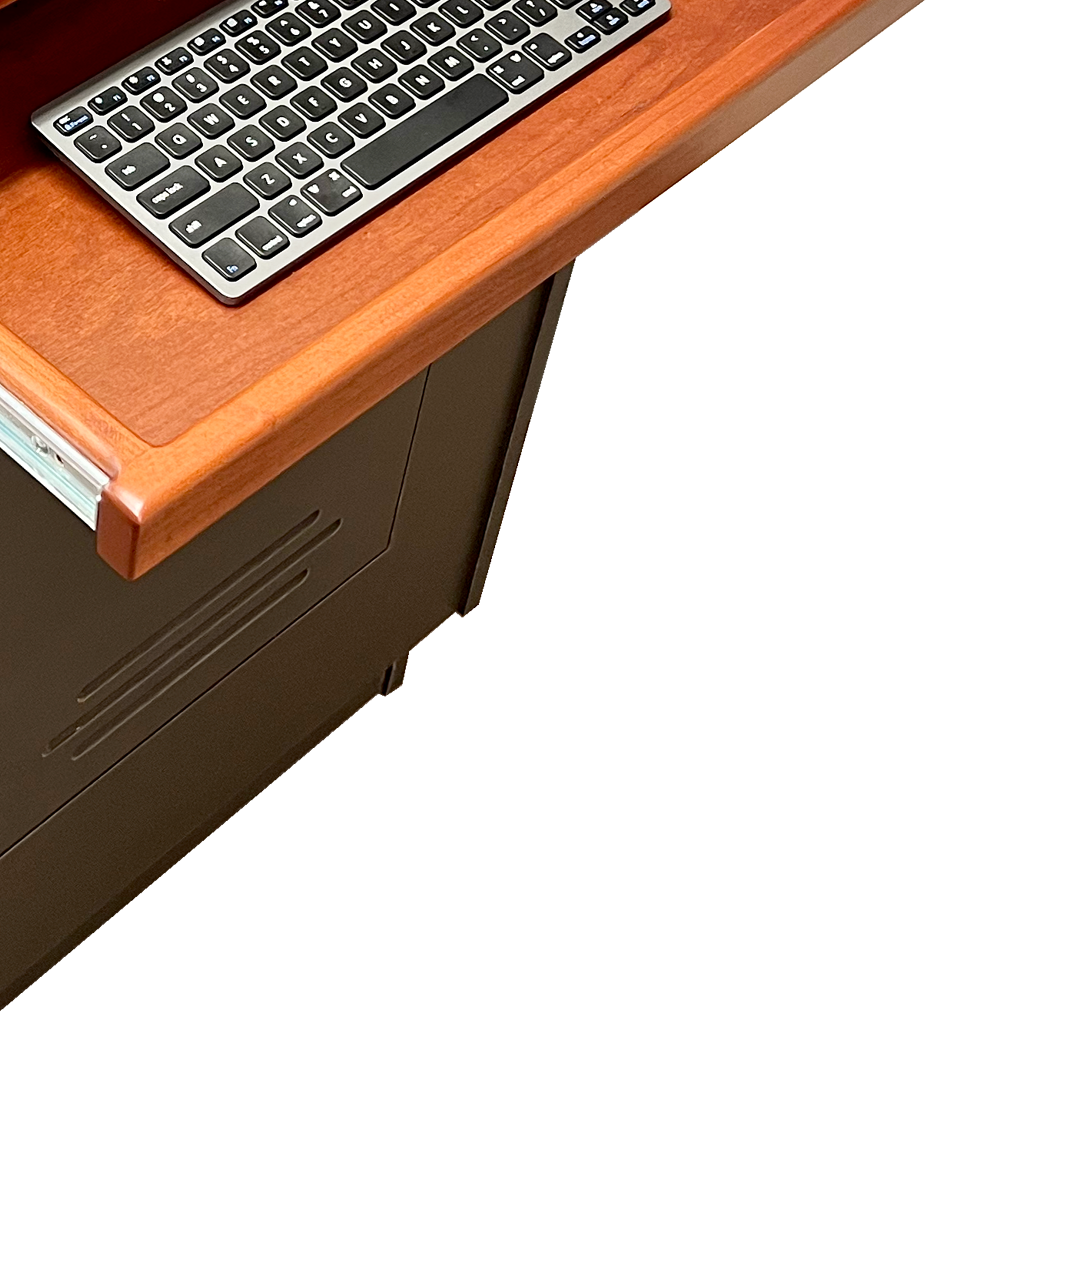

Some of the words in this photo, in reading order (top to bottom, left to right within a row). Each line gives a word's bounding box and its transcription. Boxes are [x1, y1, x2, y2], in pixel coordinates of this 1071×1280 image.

[456, 5, 469, 15] L
[357, 19, 372, 30] U
[426, 21, 441, 33] K
[328, 36, 342, 48] Y
[400, 39, 411, 51] J
[298, 56, 311, 67] T
[367, 58, 383, 70] H
[444, 56, 461, 69] M
[267, 74, 282, 87] R
[338, 76, 352, 88] G
[414, 74, 430, 86] N
[196, 82, 208, 93] 3
[236, 94, 250, 106] E
[307, 95, 320, 108] F
[164, 102, 177, 113] 2
[203, 113, 220, 126] W
[354, 112, 369, 124] V
[244, 135, 259, 147] S
[324, 132, 339, 144] C
[214, 156, 228, 168] A
[292, 152, 308, 165] X
[260, 172, 276, 185] Z
